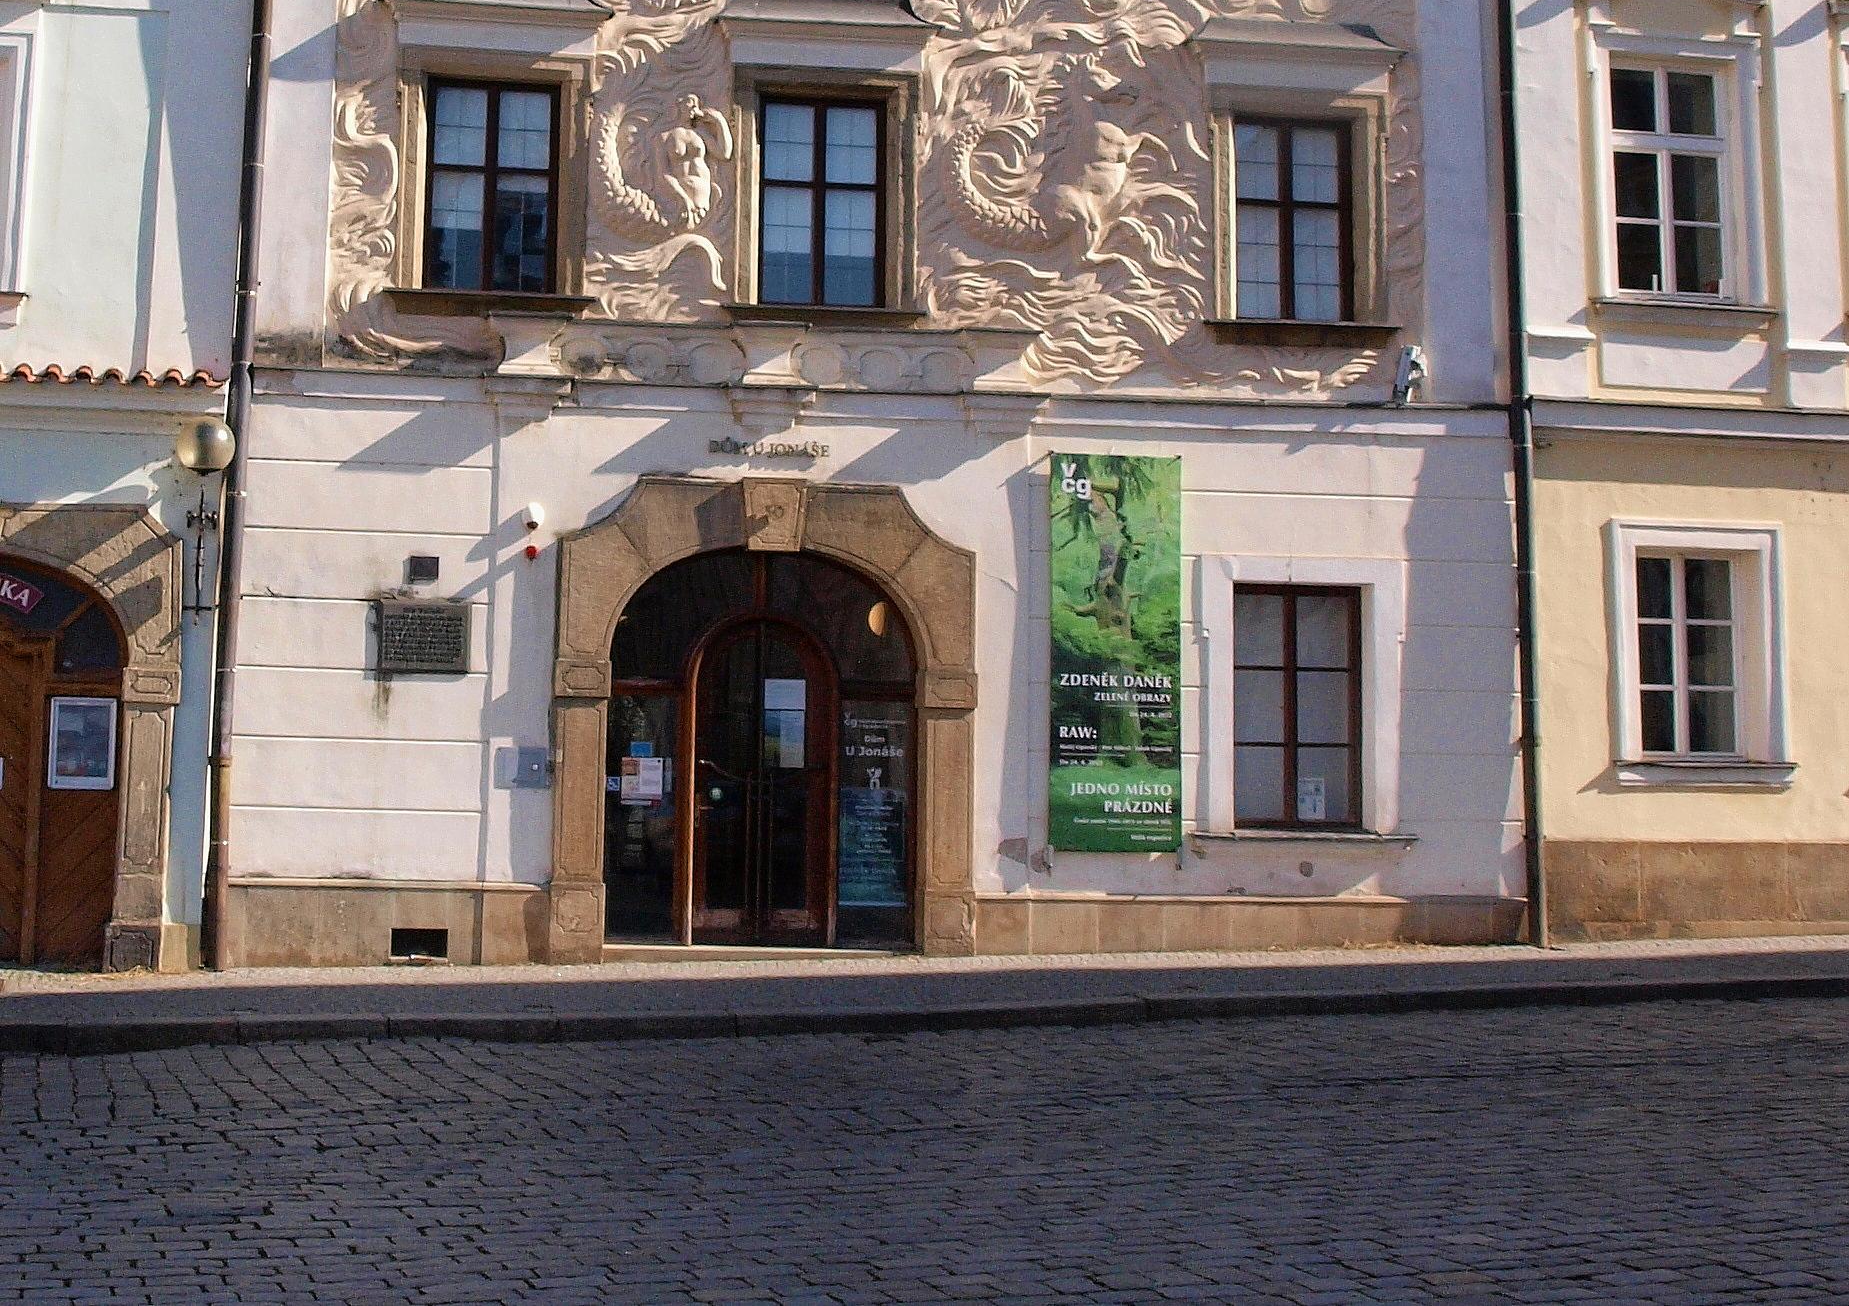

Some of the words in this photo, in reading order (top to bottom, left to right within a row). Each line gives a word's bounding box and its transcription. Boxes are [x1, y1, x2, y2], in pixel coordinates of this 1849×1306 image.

[0, 580, 30, 608] KA
[1060, 672, 1118, 687] ZDENĚK
[1060, 726, 1097, 739] RAW:
[1070, 782, 1120, 796] JEDNO
[1125, 780, 1172, 796] MÍSTO
[1103, 798, 1173, 813] PRÁZDNÉ
